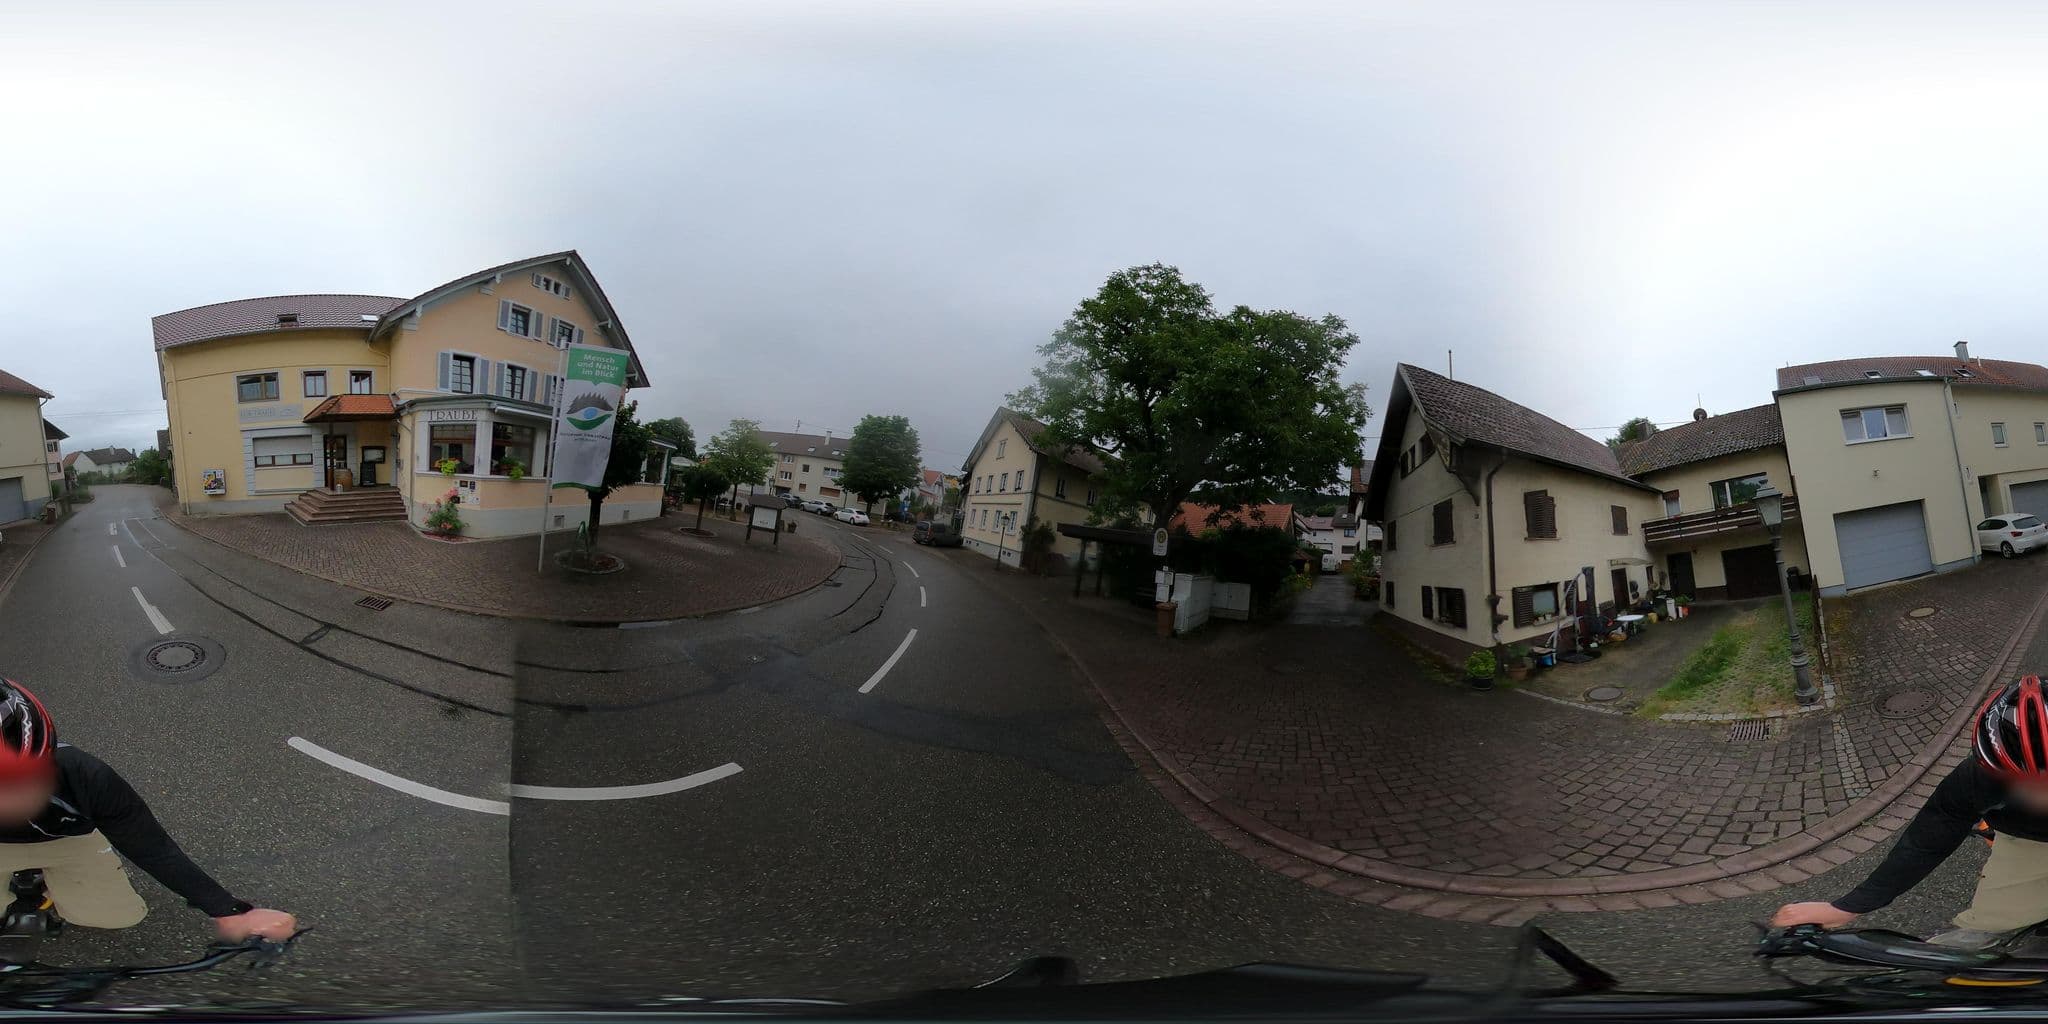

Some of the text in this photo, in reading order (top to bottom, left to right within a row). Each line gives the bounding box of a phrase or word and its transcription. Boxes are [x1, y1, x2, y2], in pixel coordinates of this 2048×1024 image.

[583, 354, 615, 364] Mensch
[596, 362, 619, 371] Natur
[595, 369, 615, 378] Blick
[429, 409, 478, 420] TRAUBE
